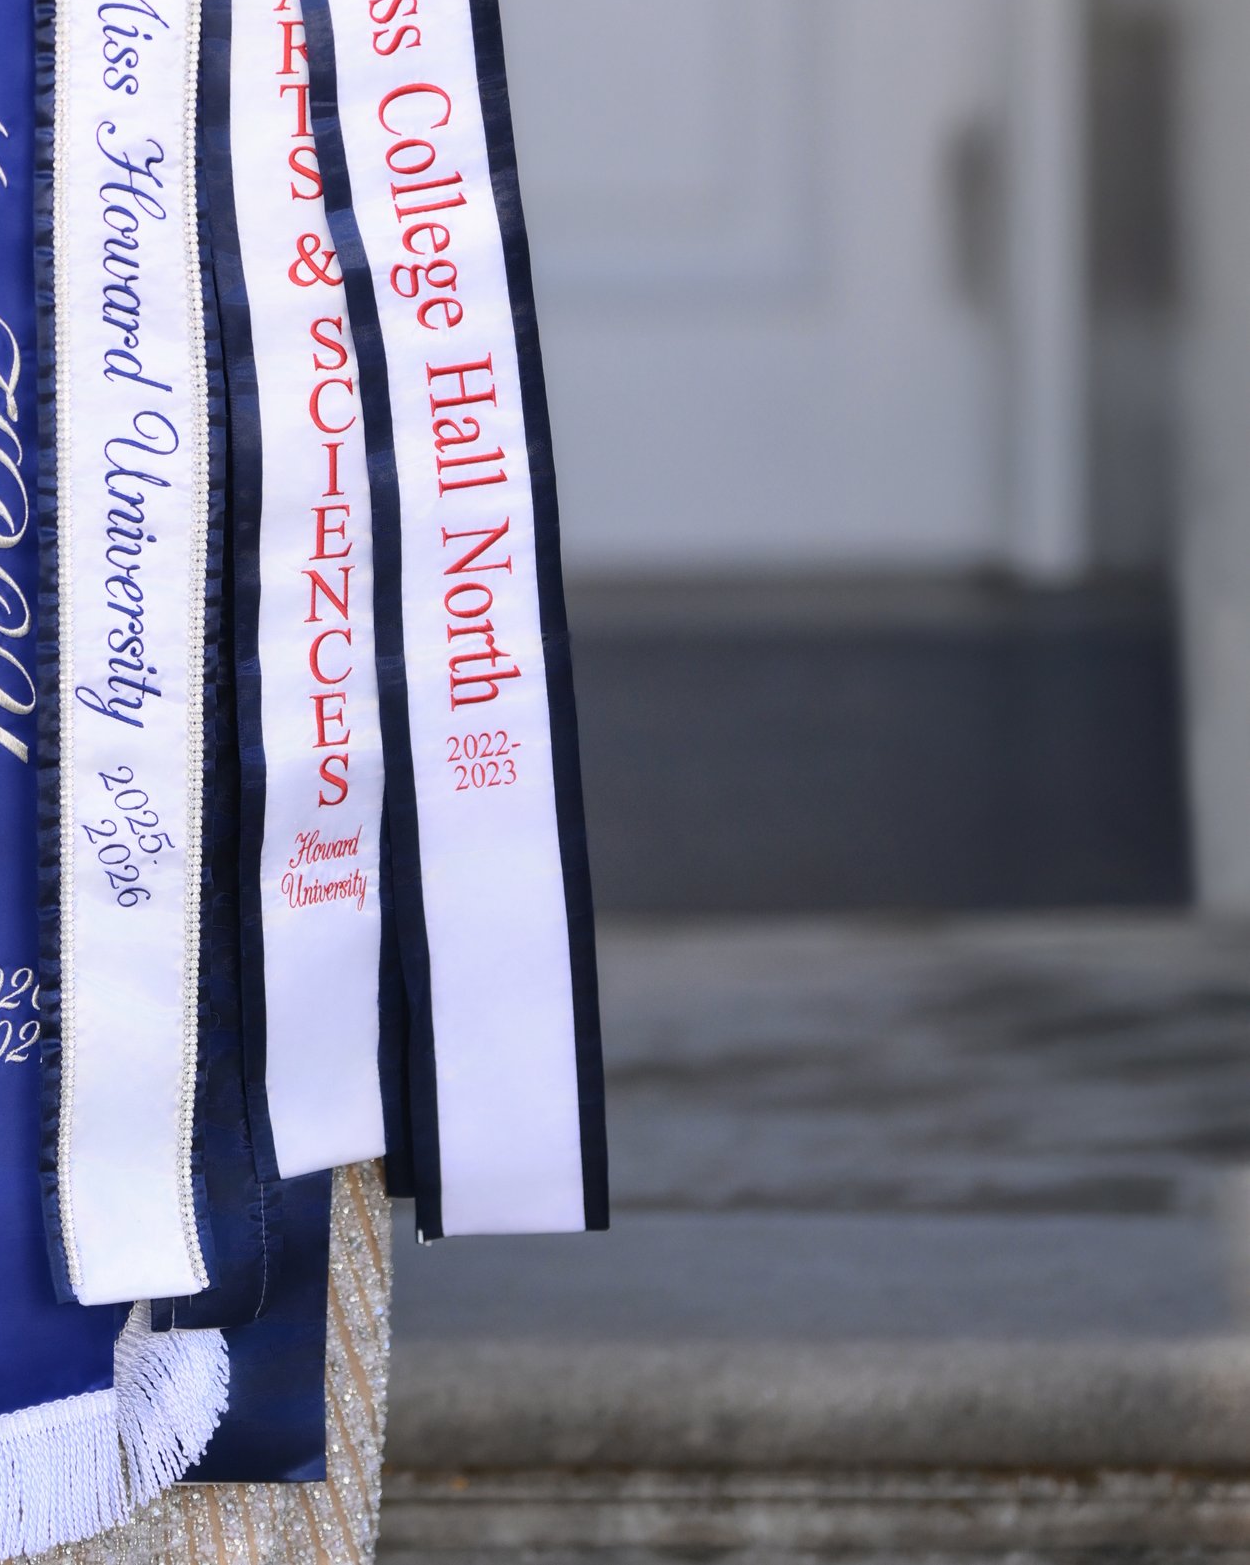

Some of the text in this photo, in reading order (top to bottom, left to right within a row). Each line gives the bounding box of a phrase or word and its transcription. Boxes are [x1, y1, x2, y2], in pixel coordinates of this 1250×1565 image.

[95, 120, 174, 394] Howard
[288, 232, 345, 288] &
[378, 82, 468, 331] College
[425, 351, 509, 499] Hall
[75, 410, 180, 729] University
[300, 316, 357, 809] SCIENCES
[441, 516, 522, 712] North
[446, 730, 522, 763] 2022-
[455, 759, 518, 792] 2023
[81, 819, 152, 908] 2026
[281, 867, 368, 912] University
[288, 824, 364, 869] Howard
